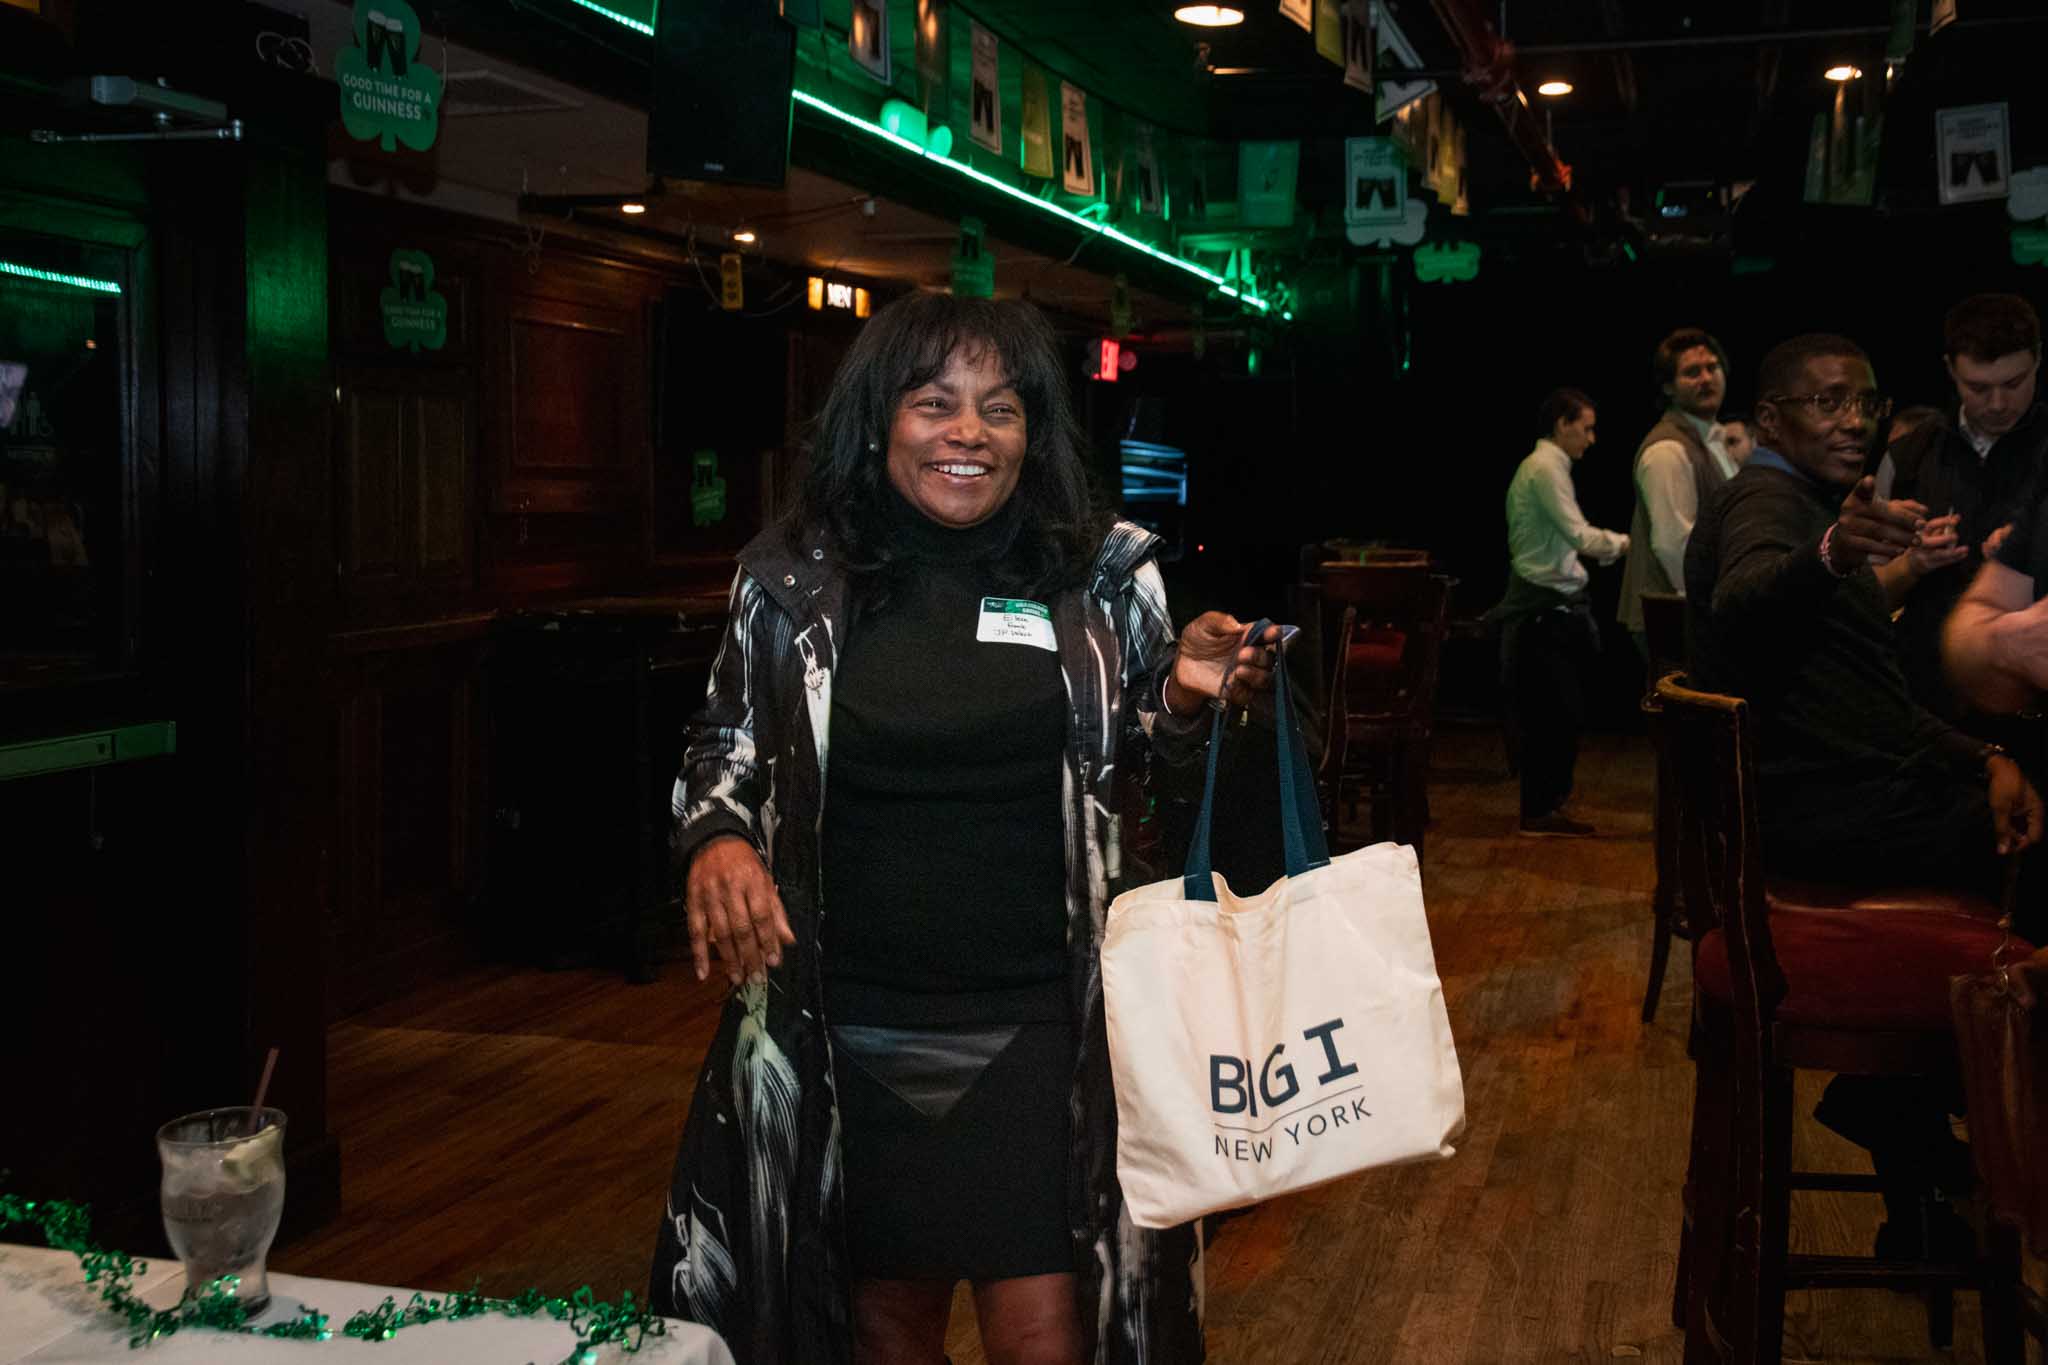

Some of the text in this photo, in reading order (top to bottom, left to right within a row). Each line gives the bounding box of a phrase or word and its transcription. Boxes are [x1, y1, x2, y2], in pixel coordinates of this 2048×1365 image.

[343, 73, 432, 104] GOOD TIME FOR A
[353, 91, 421, 120] GUINNESS
[1210, 1017, 1359, 1118] BIG I
[1215, 1096, 1372, 1163] NEW YORK
